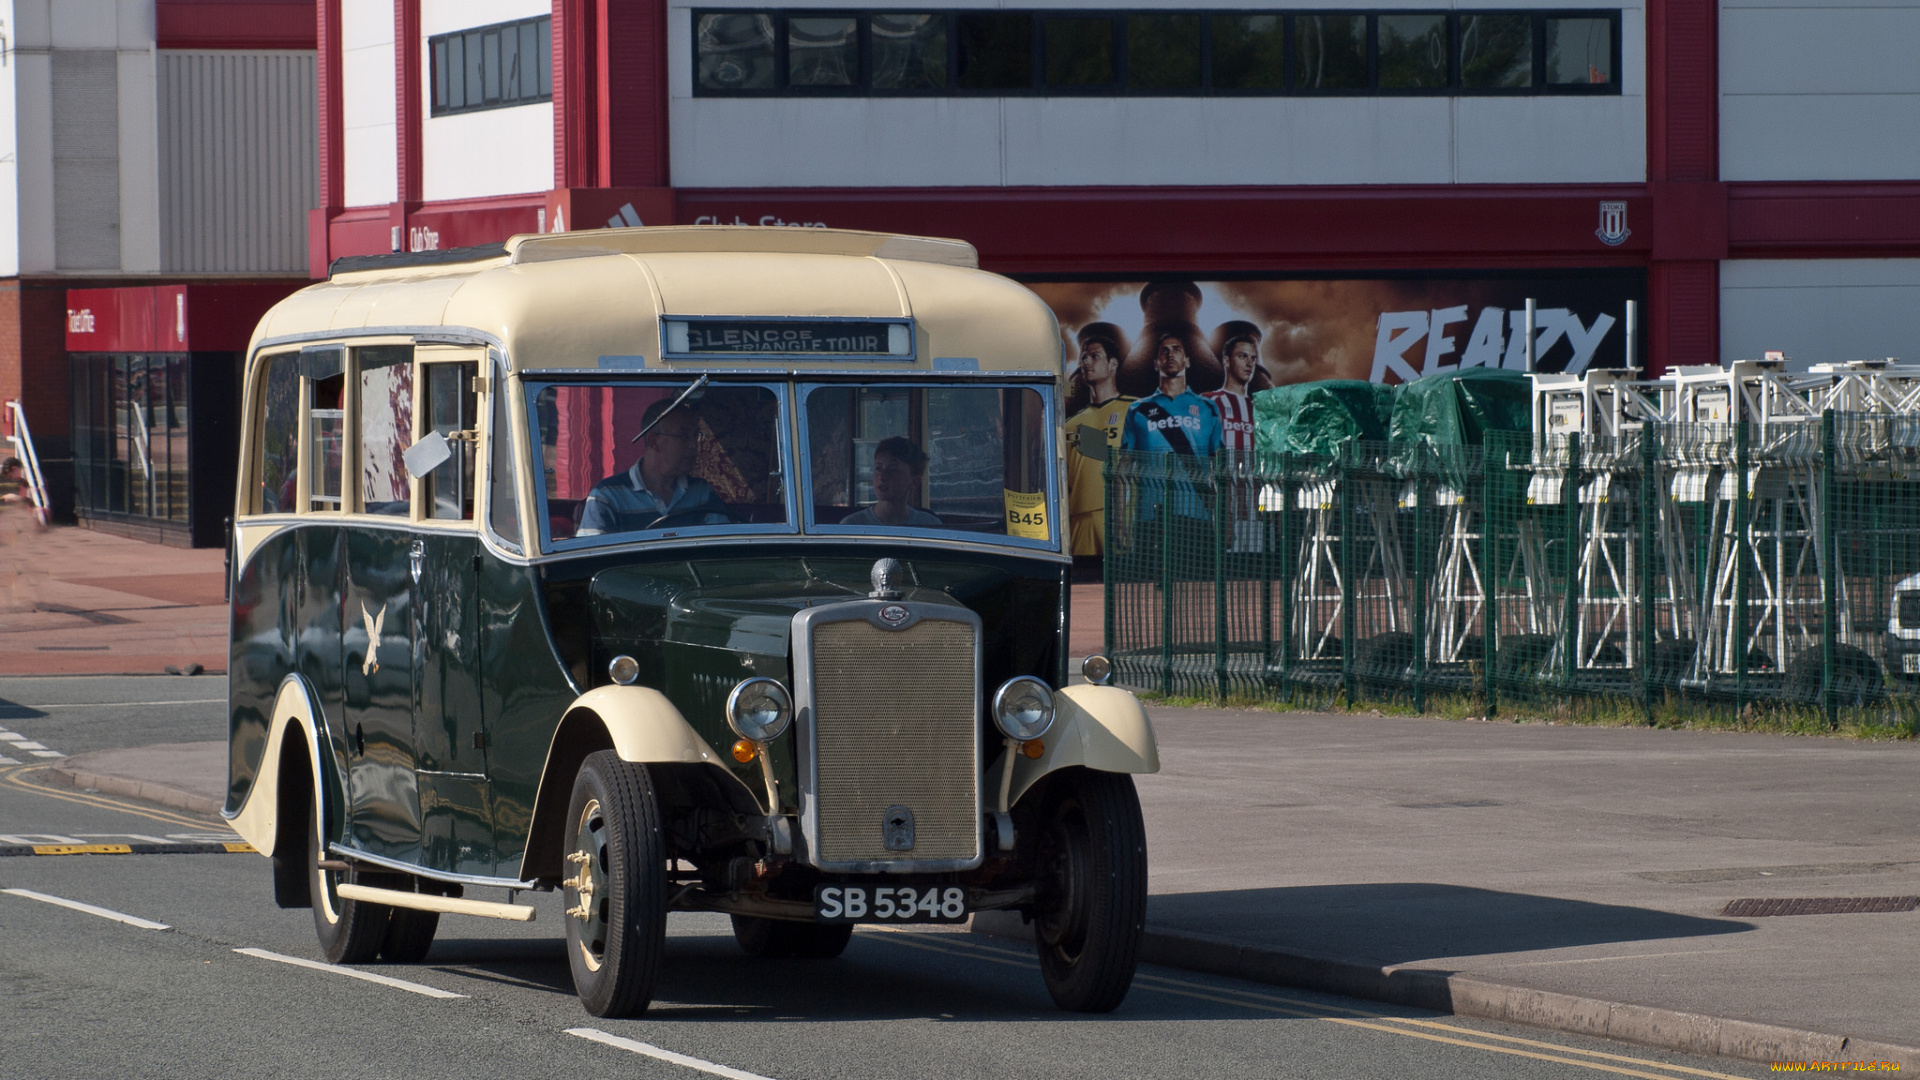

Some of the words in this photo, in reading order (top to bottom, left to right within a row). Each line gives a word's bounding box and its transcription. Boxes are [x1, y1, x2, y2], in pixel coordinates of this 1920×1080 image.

[694, 215, 748, 226] Clb
[410, 228, 423, 253] Club
[424, 226, 439, 251] Store
[688, 329, 813, 347] GLENCOE
[732, 339, 822, 352] TRIANGLE
[826, 335, 878, 352] TOUR
[1369, 304, 1616, 384] READY
[1147, 415, 1201, 432] bet365
[1009, 510, 1044, 525] B45
[820, 887, 867, 919] SB
[874, 887, 965, 919] 5348
